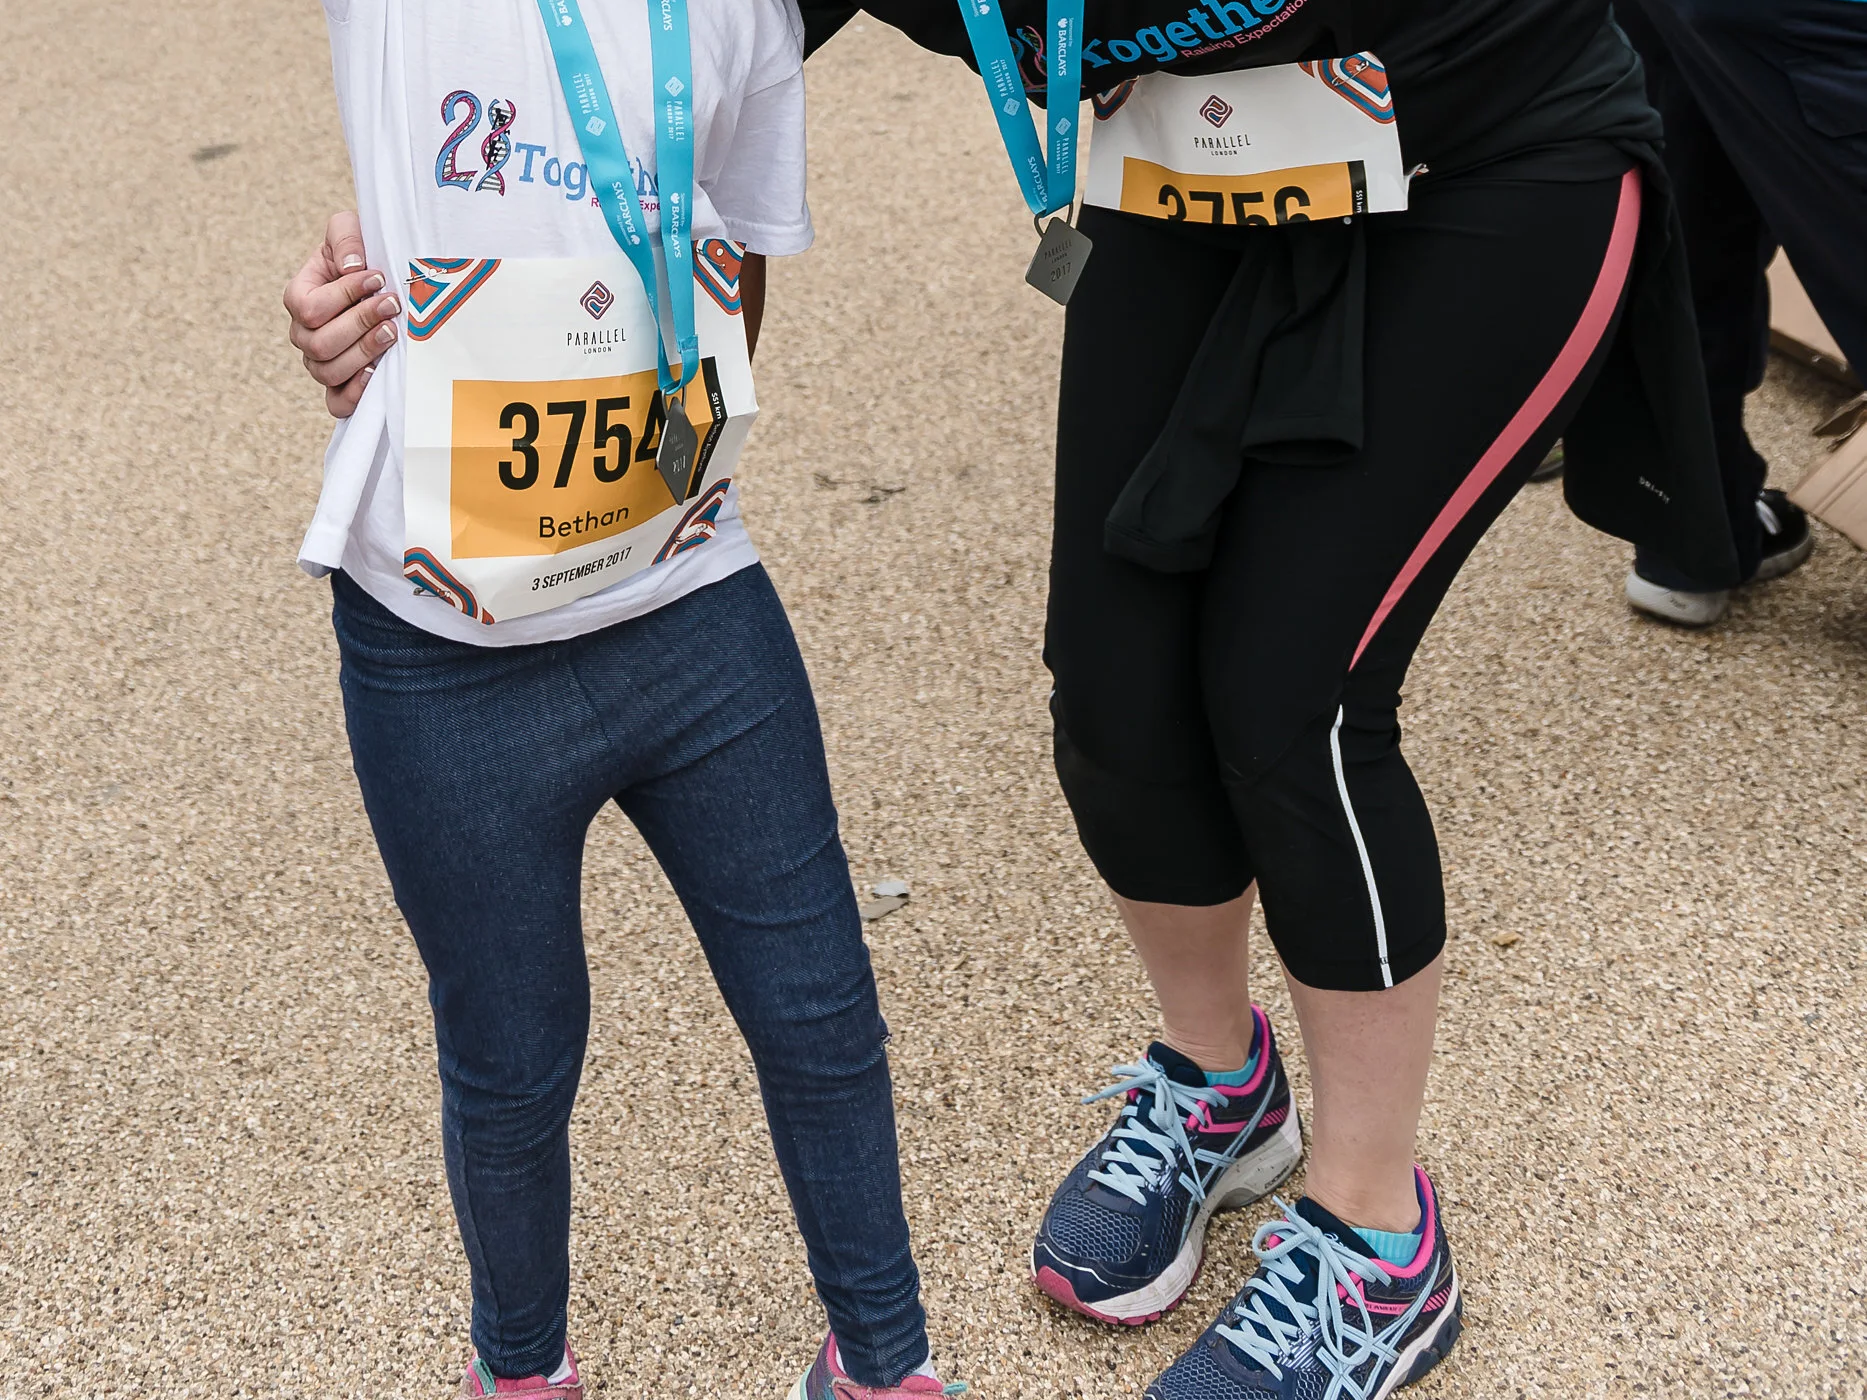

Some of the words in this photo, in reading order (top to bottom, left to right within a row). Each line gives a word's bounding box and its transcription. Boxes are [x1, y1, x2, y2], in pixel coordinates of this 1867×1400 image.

[1057, 30, 1067, 77] BARCLAYS
[1181, 38, 1235, 58] Raising
[572, 72, 593, 115] PARALLEL
[991, 59, 1009, 97] PARALLEL
[674, 100, 686, 143] PARALLEL
[1061, 137, 1069, 175] PARALLEL
[1194, 134, 1251, 149] PARALLEL
[611, 181, 636, 233] BARCLAYS
[670, 206, 682, 259] BARCLAYS
[1050, 262, 1072, 282] 2017
[567, 327, 627, 346] PARALLEL
[584, 346, 612, 355] LONDON
[715, 406, 722, 420] km
[538, 506, 629, 538] Bethan
[532, 578, 539, 591] 3
[541, 559, 605, 589] SEPTEMBER
[605, 547, 632, 569] 2017
